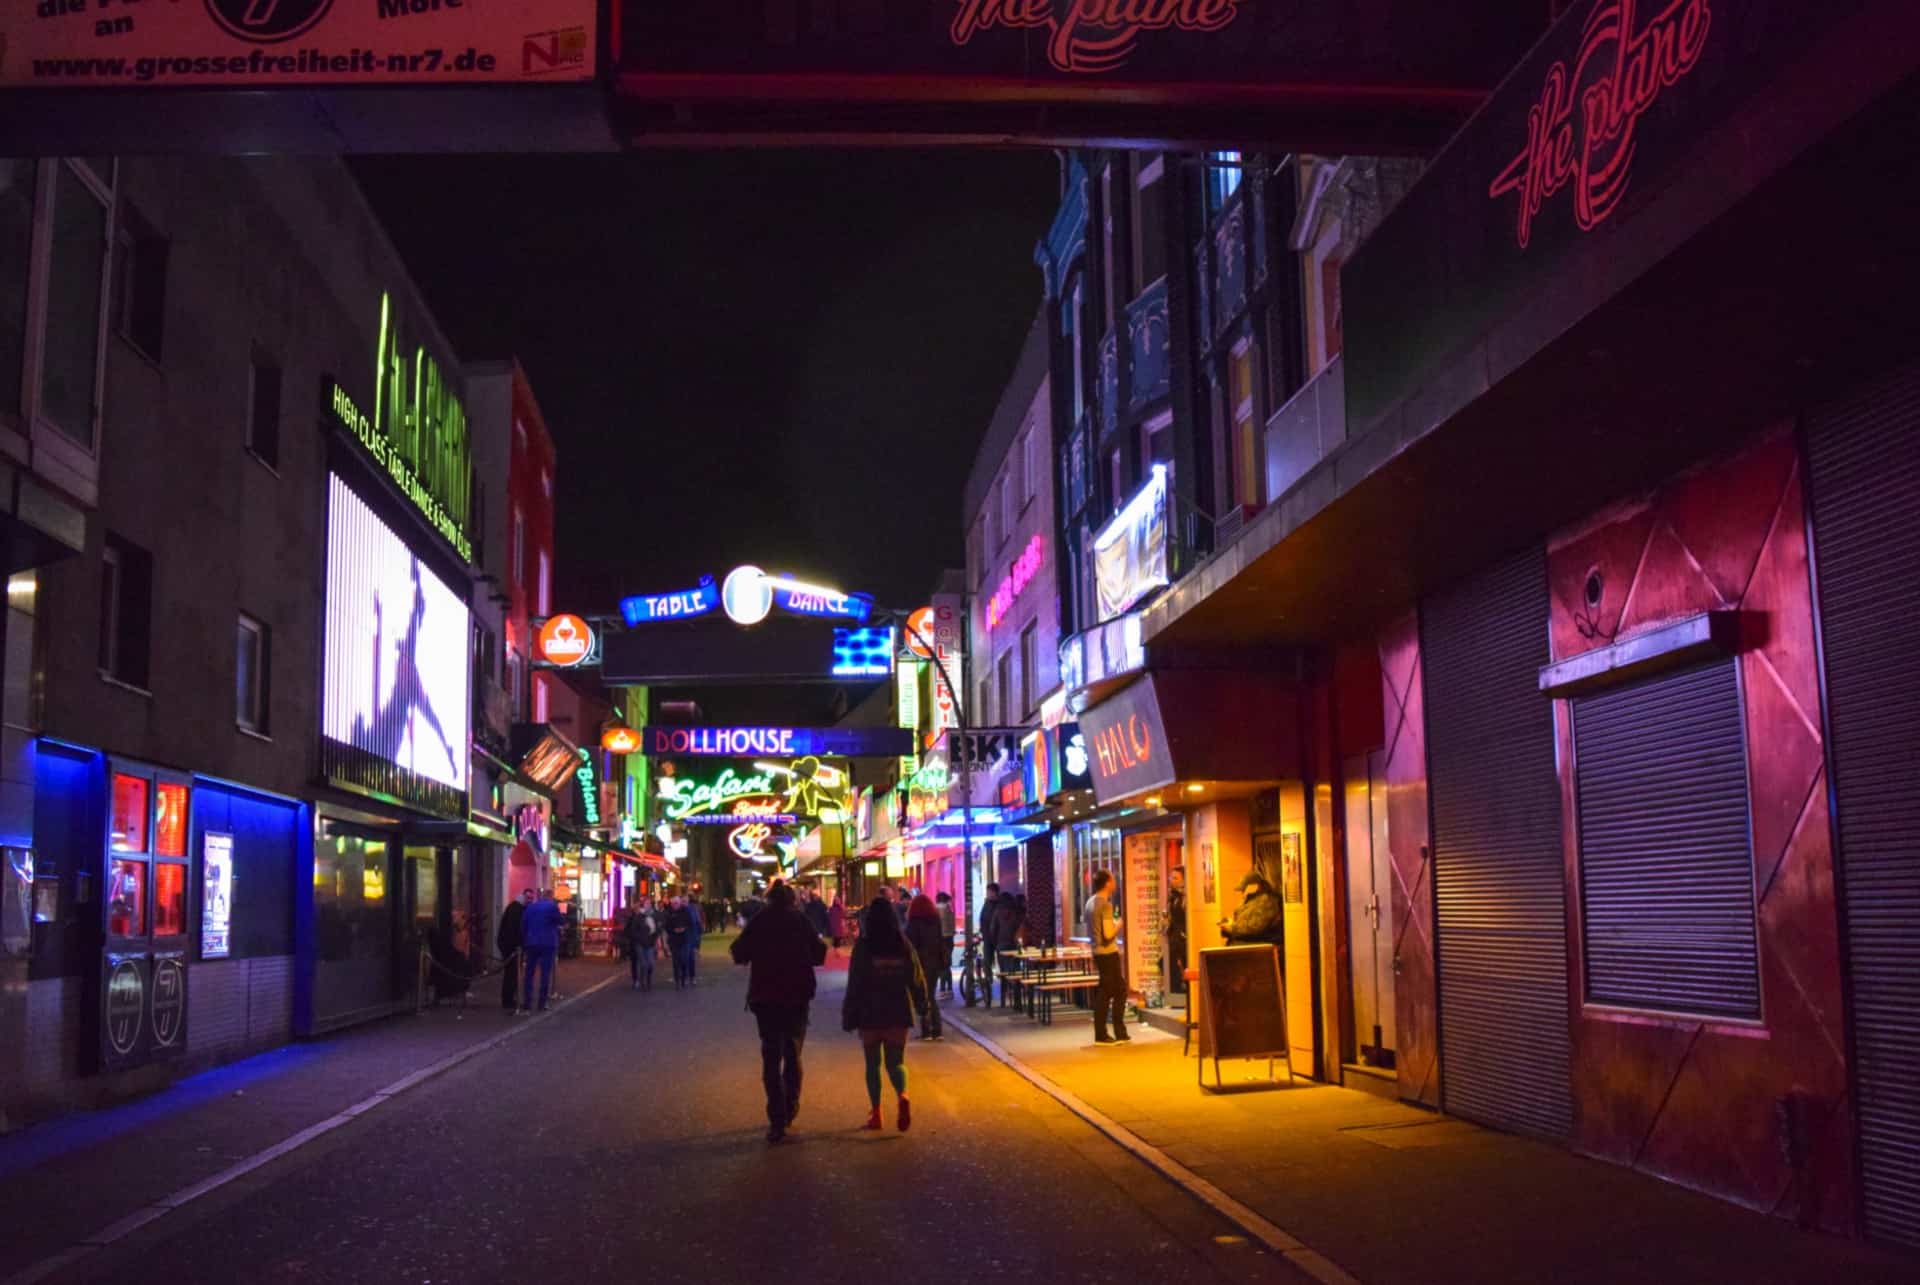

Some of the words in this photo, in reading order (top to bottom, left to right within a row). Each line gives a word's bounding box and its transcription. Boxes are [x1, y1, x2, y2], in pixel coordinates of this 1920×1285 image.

[95, 15, 134, 37] an
[33, 49, 496, 81] www.grossefreiheit-nr7.de
[332, 383, 358, 434] HIGH
[358, 415, 387, 466] CLASS
[387, 448, 411, 496] TABLE
[646, 591, 707, 617] TABLE
[788, 590, 849, 614] DANCE
[655, 728, 795, 754] DOLLHOUSE
[1093, 712, 1151, 778] HALO
[576, 747, 600, 823] O'Brians
[666, 768, 776, 818] Safari
